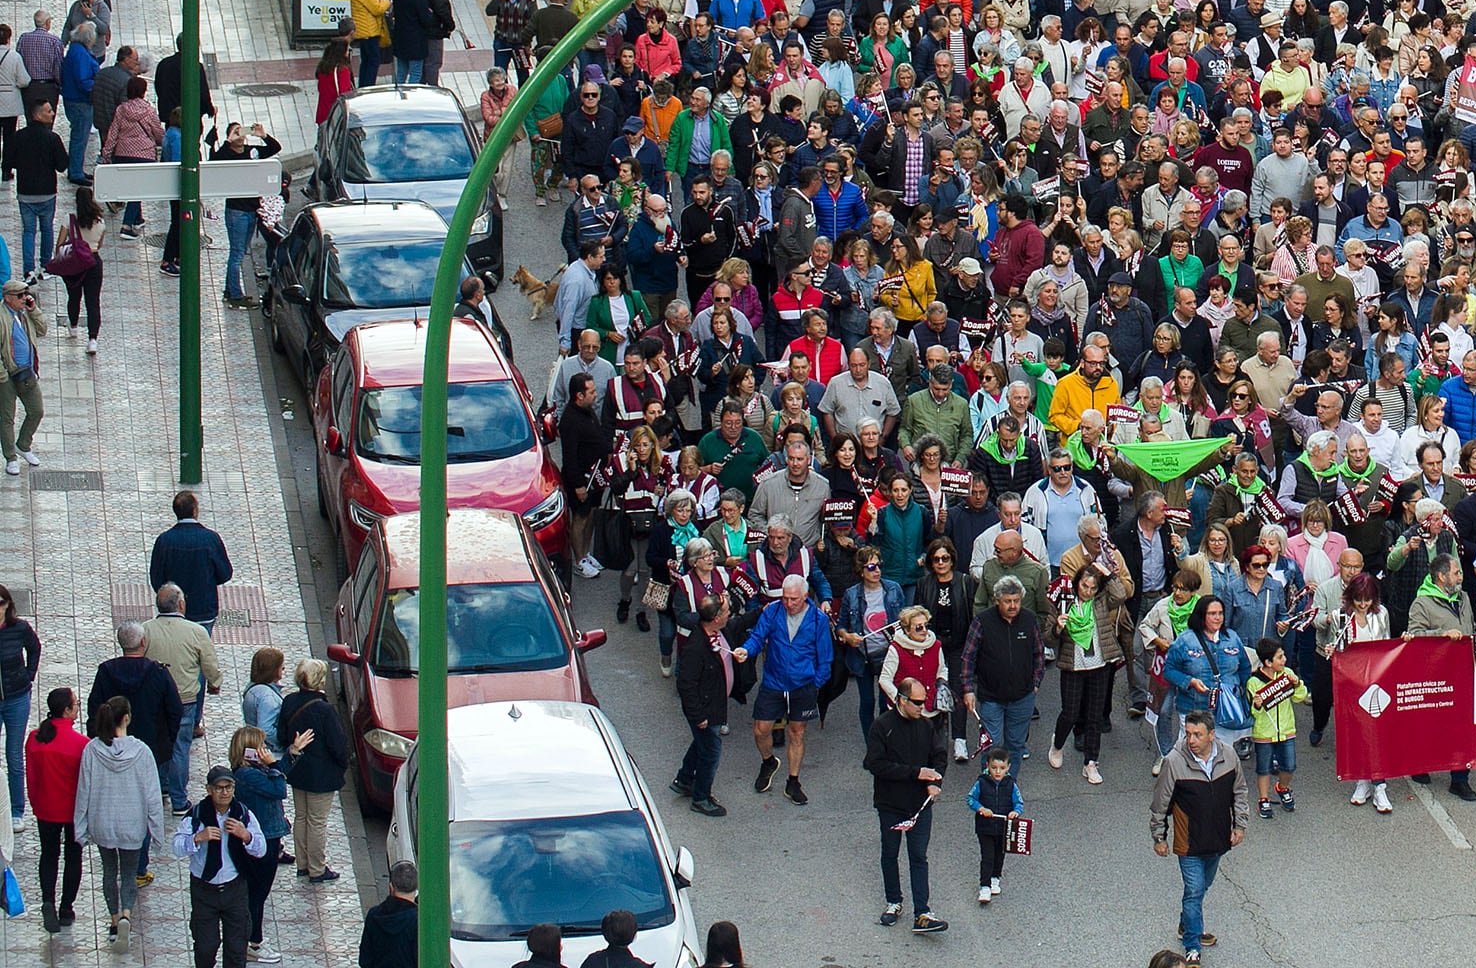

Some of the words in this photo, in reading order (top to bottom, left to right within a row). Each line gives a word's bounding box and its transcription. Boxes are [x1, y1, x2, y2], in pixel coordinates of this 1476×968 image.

[307, 5, 346, 15] Yellow
[1216, 158, 1242, 169] tommy
[1108, 407, 1139, 420] BURGOS
[941, 471, 970, 484] BURGOS
[825, 501, 855, 512] BURGOS
[1341, 493, 1361, 523] BURGOS
[1260, 676, 1290, 701] BURGOS
[1016, 820, 1028, 853] BURGOS
